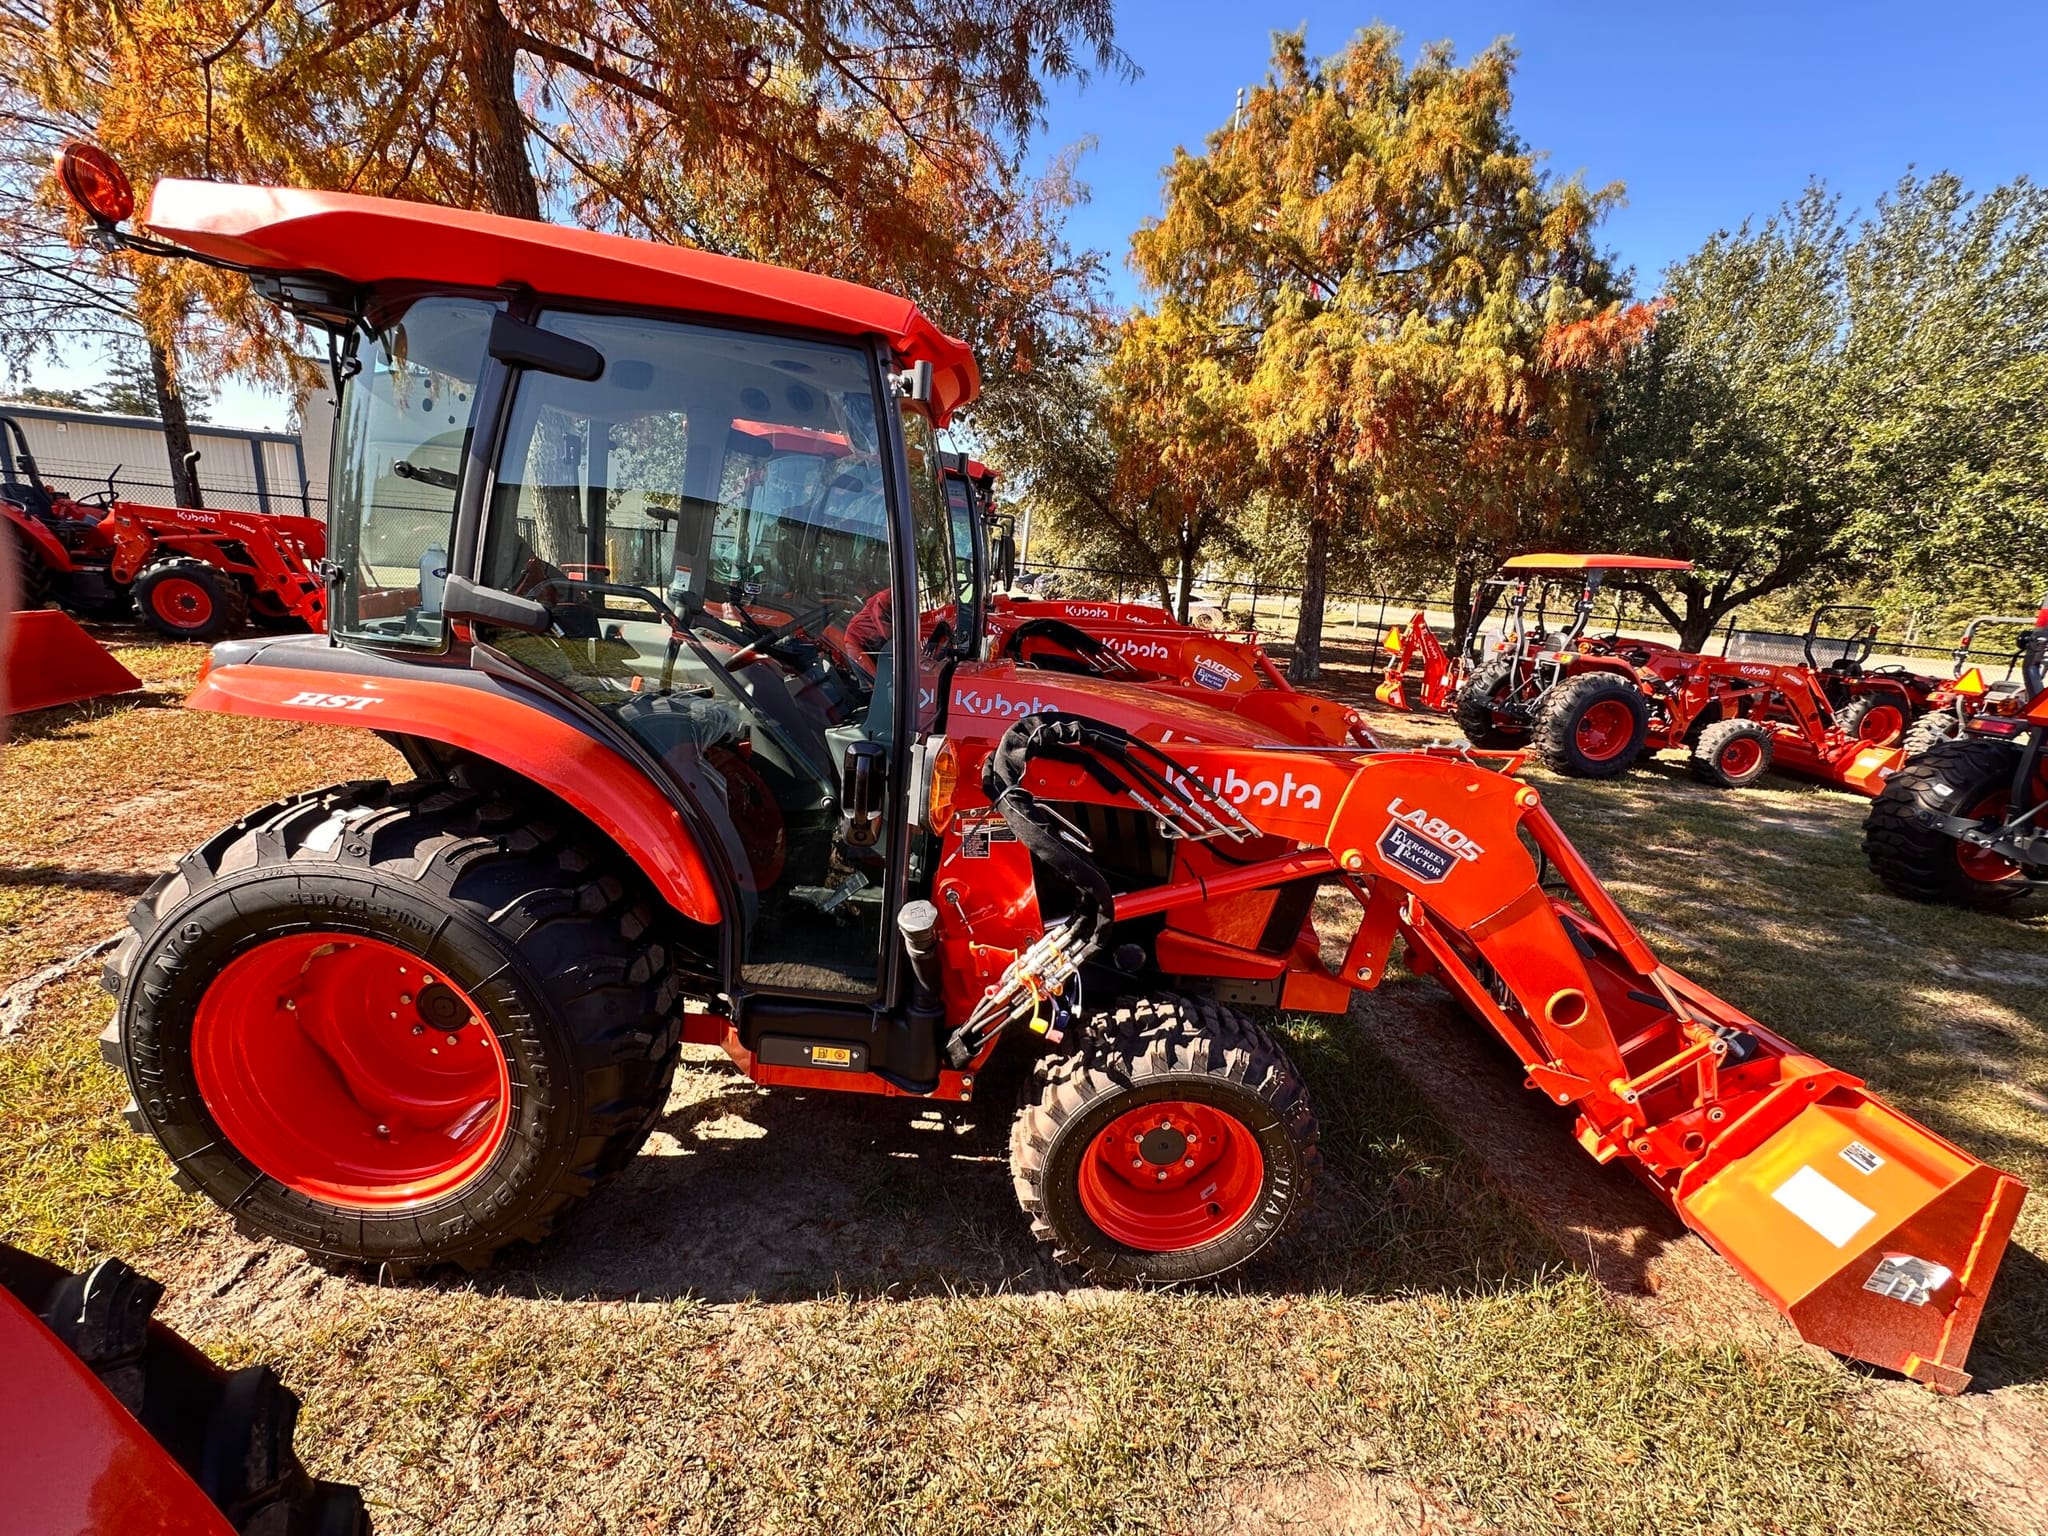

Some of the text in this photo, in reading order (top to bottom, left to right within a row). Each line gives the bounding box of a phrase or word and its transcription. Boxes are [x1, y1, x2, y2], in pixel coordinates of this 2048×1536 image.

[177, 511, 216, 523] Kubota
[1065, 605, 1109, 618] Kubota
[1102, 637, 1168, 659] Kubota
[1740, 665, 1770, 676] Kubota
[281, 691, 385, 710] HST
[1165, 765, 1321, 809] Kubota
[1387, 797, 1486, 862] LA805
[1389, 827, 1447, 867] EVERGREEN
[1392, 843, 1442, 876] TRACTOR
[131, 938, 189, 1090] TITAN
